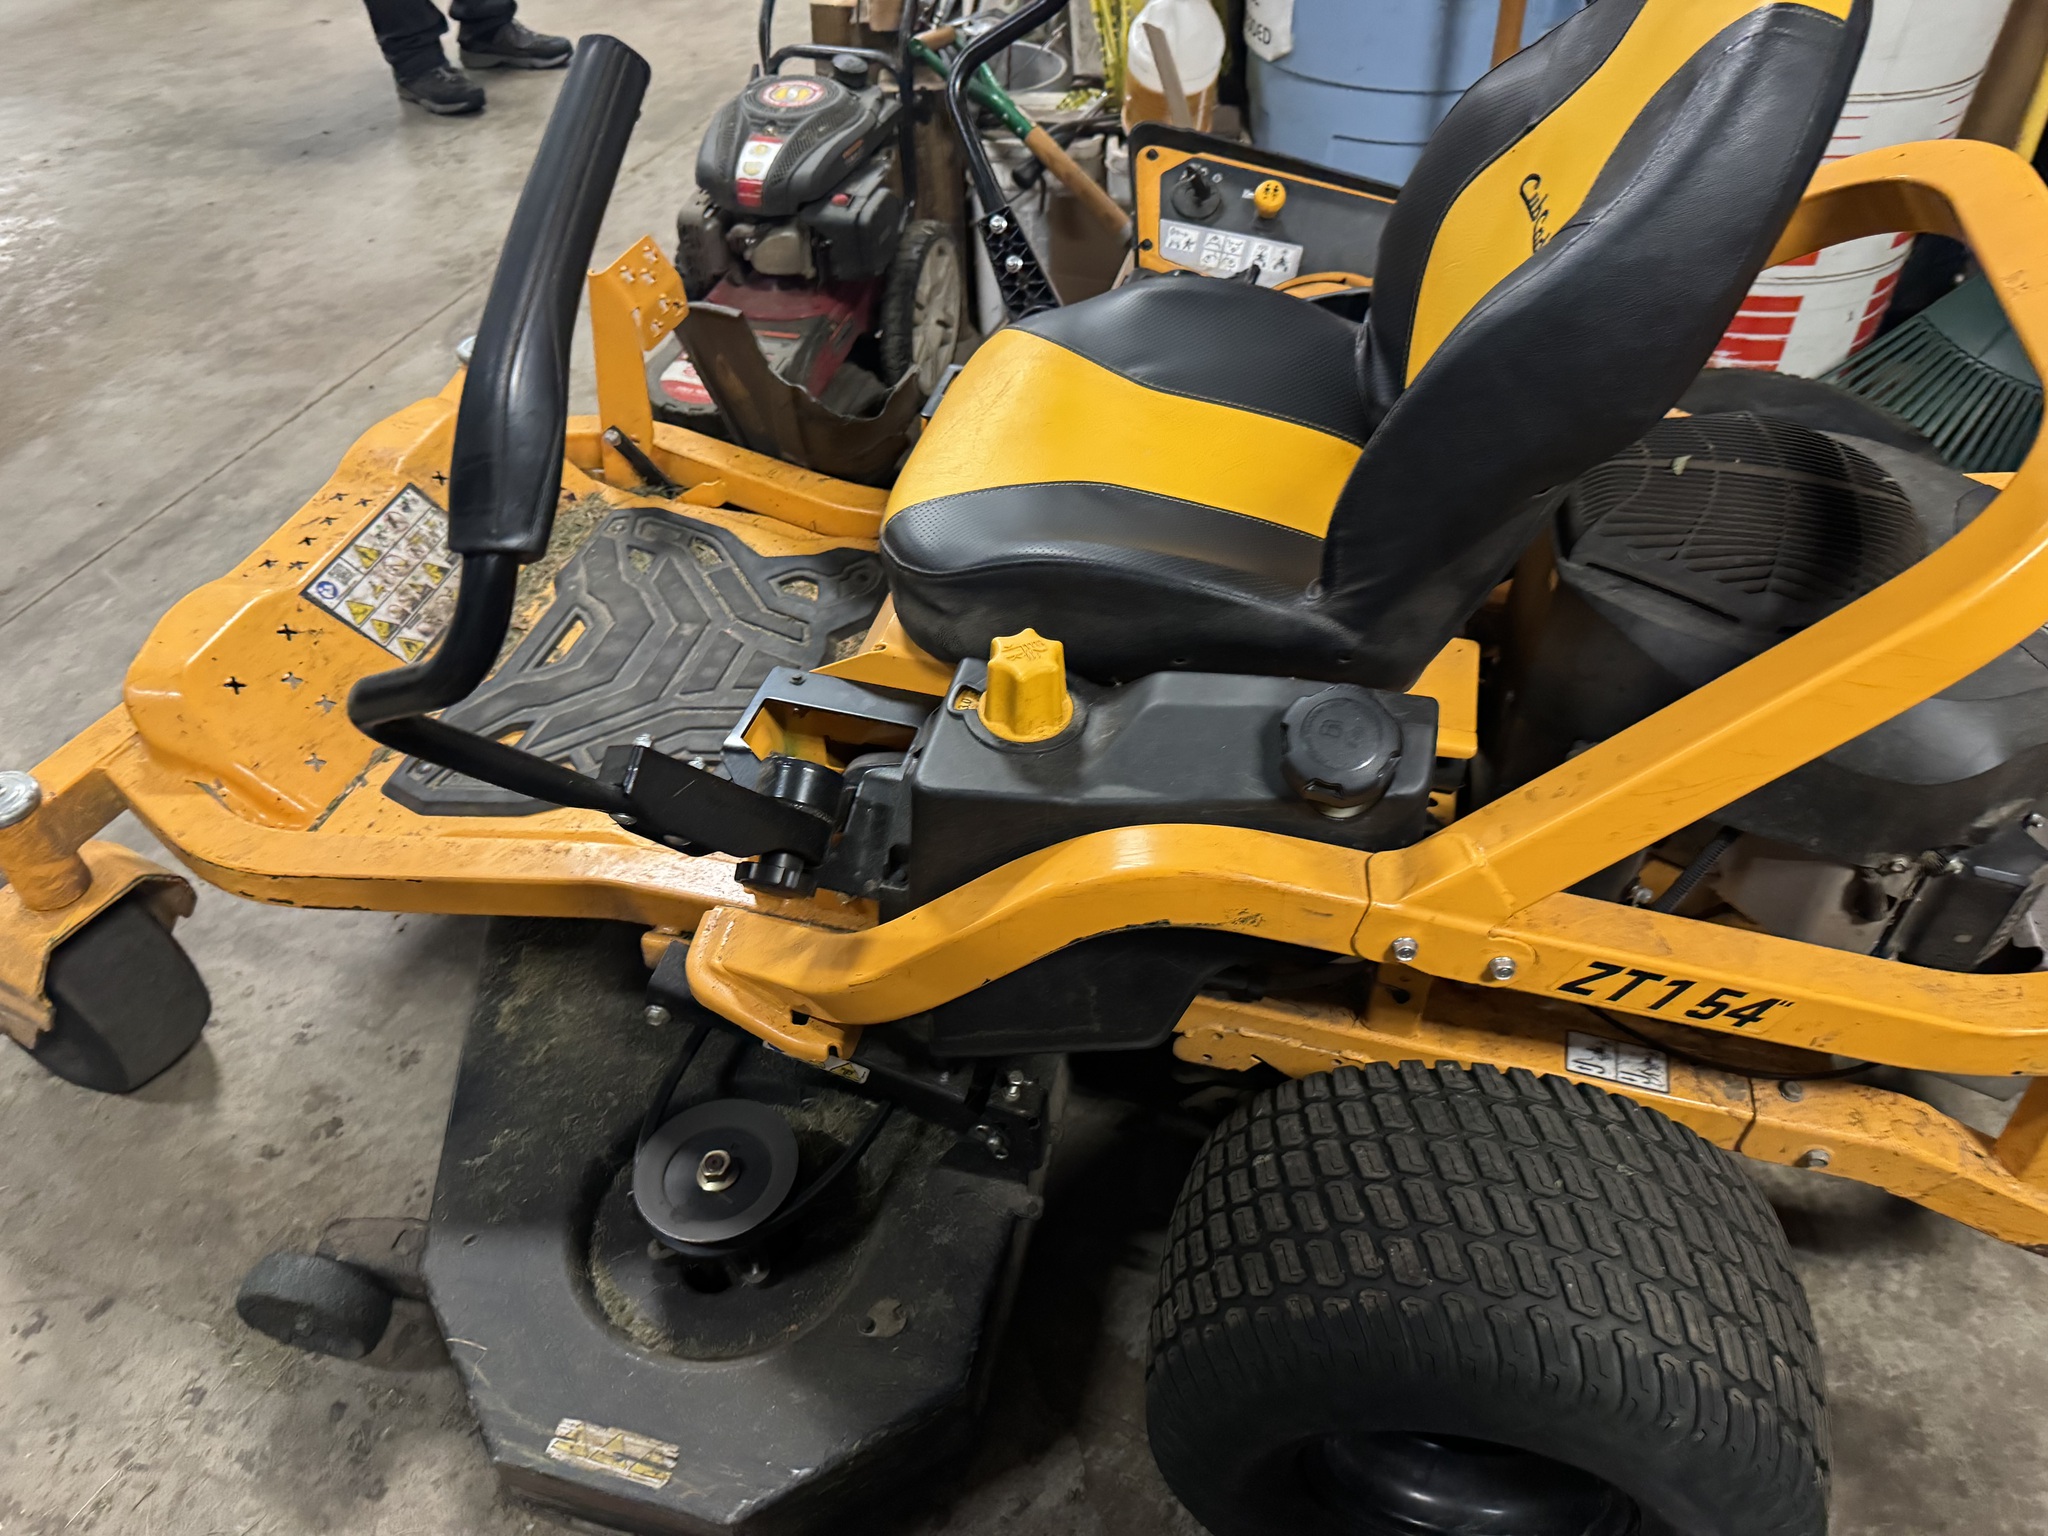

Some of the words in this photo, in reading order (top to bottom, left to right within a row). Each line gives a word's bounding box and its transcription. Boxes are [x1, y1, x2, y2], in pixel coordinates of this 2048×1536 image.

[1520, 173, 1548, 221] Cub
[1557, 961, 1697, 1010] ZT1
[1685, 988, 1796, 1028] 54"
